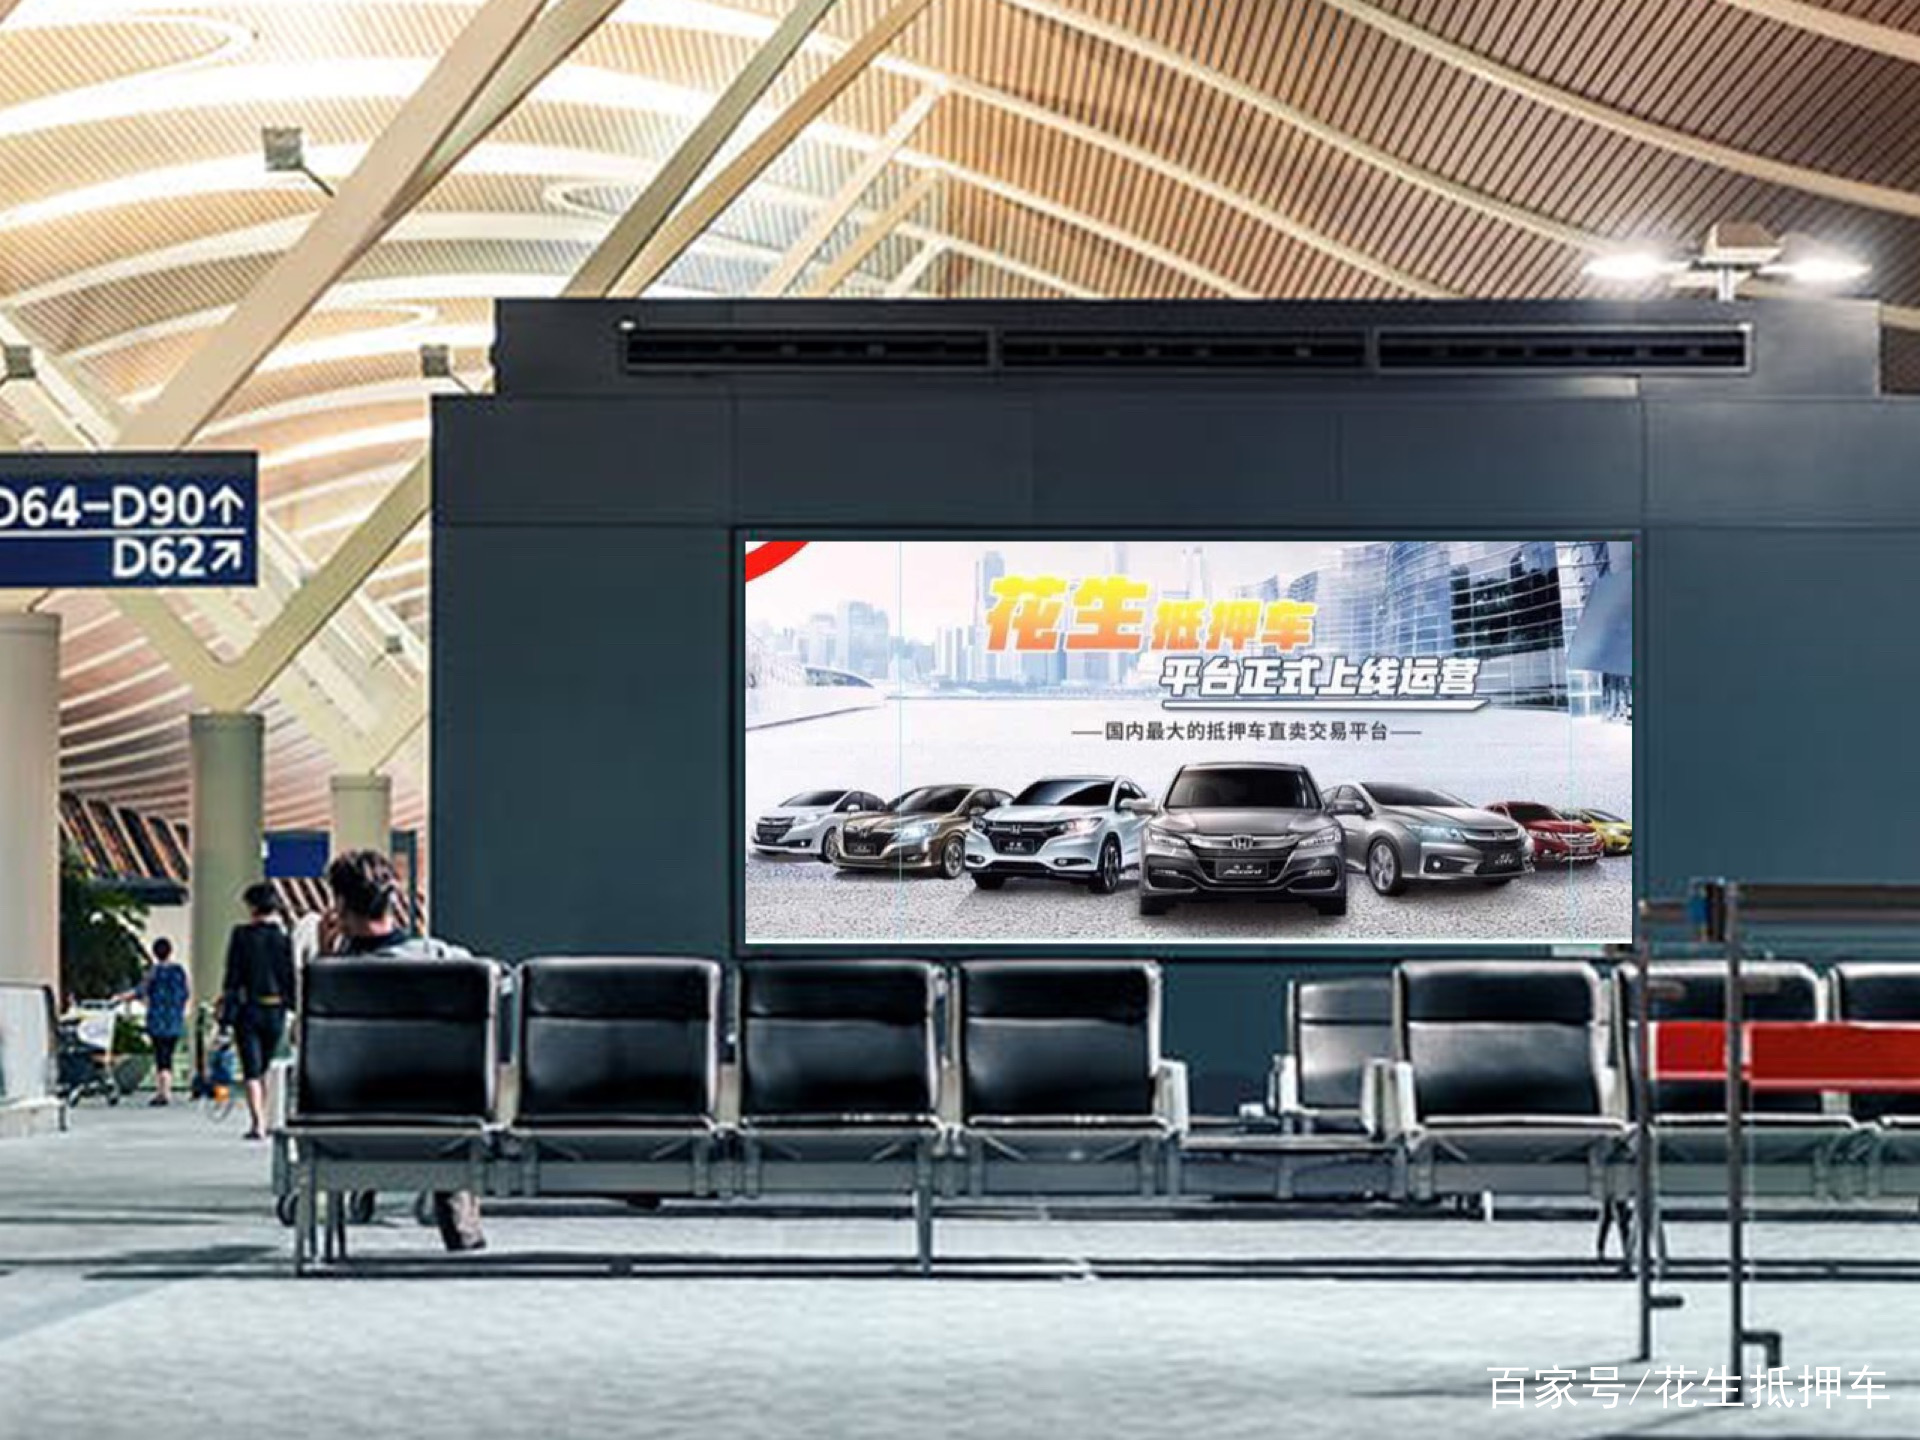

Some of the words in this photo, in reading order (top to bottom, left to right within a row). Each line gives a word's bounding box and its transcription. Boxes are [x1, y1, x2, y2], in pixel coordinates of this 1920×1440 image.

[112, 537, 205, 578] D62
[985, 575, 1318, 652] 花生抵押车
[1159, 656, 1481, 697] 平台正式上线运营
